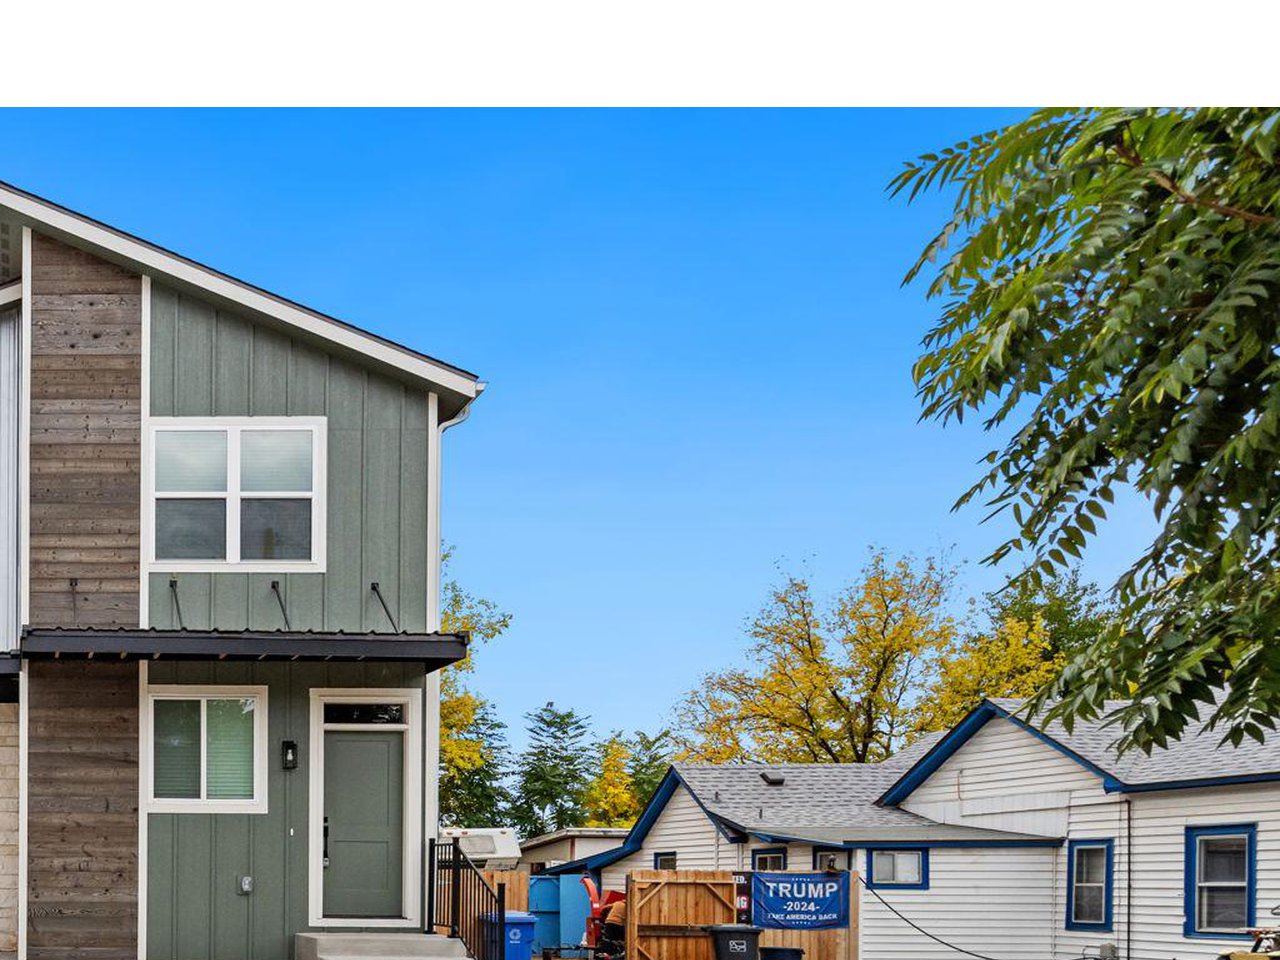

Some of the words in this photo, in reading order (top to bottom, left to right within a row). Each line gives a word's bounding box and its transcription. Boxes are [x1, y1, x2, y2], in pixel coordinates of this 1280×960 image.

[766, 882, 838, 898] TRUMP
[783, 902, 820, 912] -2024-
[786, 911, 817, 921] AMERICA
[818, 912, 838, 920] BACK
